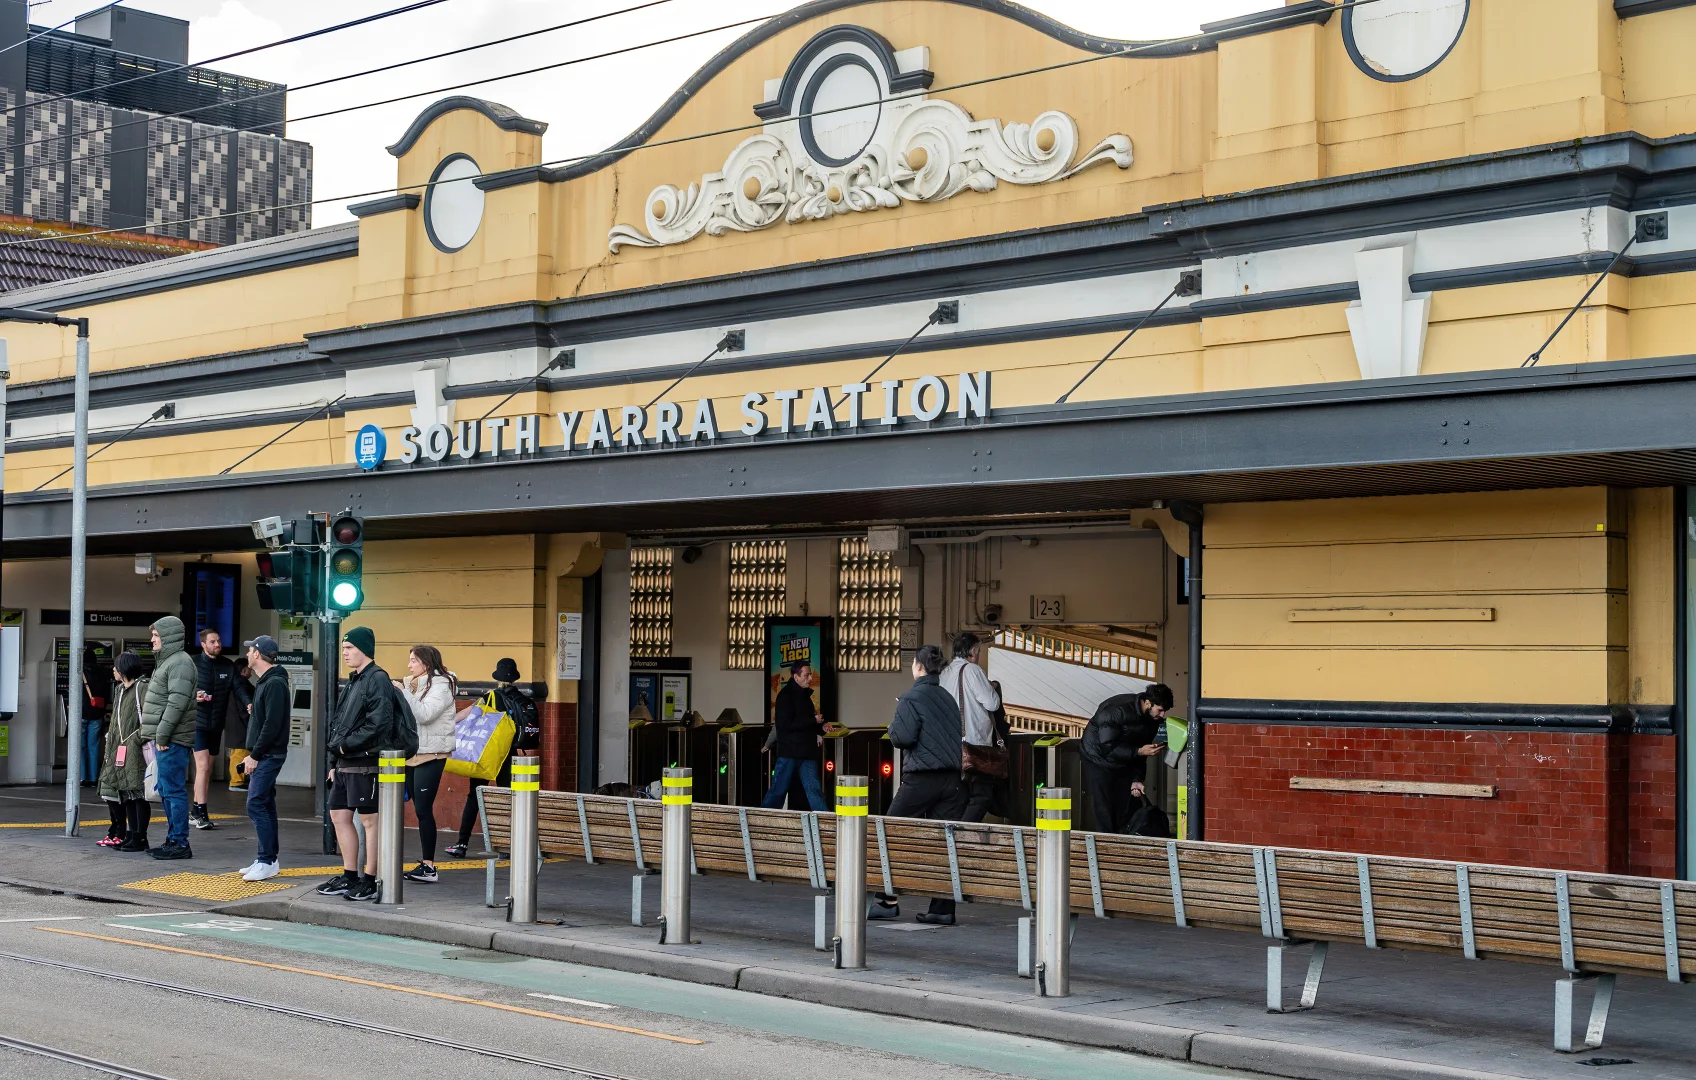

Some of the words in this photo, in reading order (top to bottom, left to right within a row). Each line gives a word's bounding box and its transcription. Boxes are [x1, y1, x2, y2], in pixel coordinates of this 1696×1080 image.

[401, 415, 540, 464] SOUTH
[558, 398, 719, 450] YARRA
[741, 371, 991, 435] STATION
[99, 614, 123, 622] Tickets
[790, 637, 809, 650] NEW
[288, 655, 303, 663] Charging
[780, 644, 810, 662] Taco
